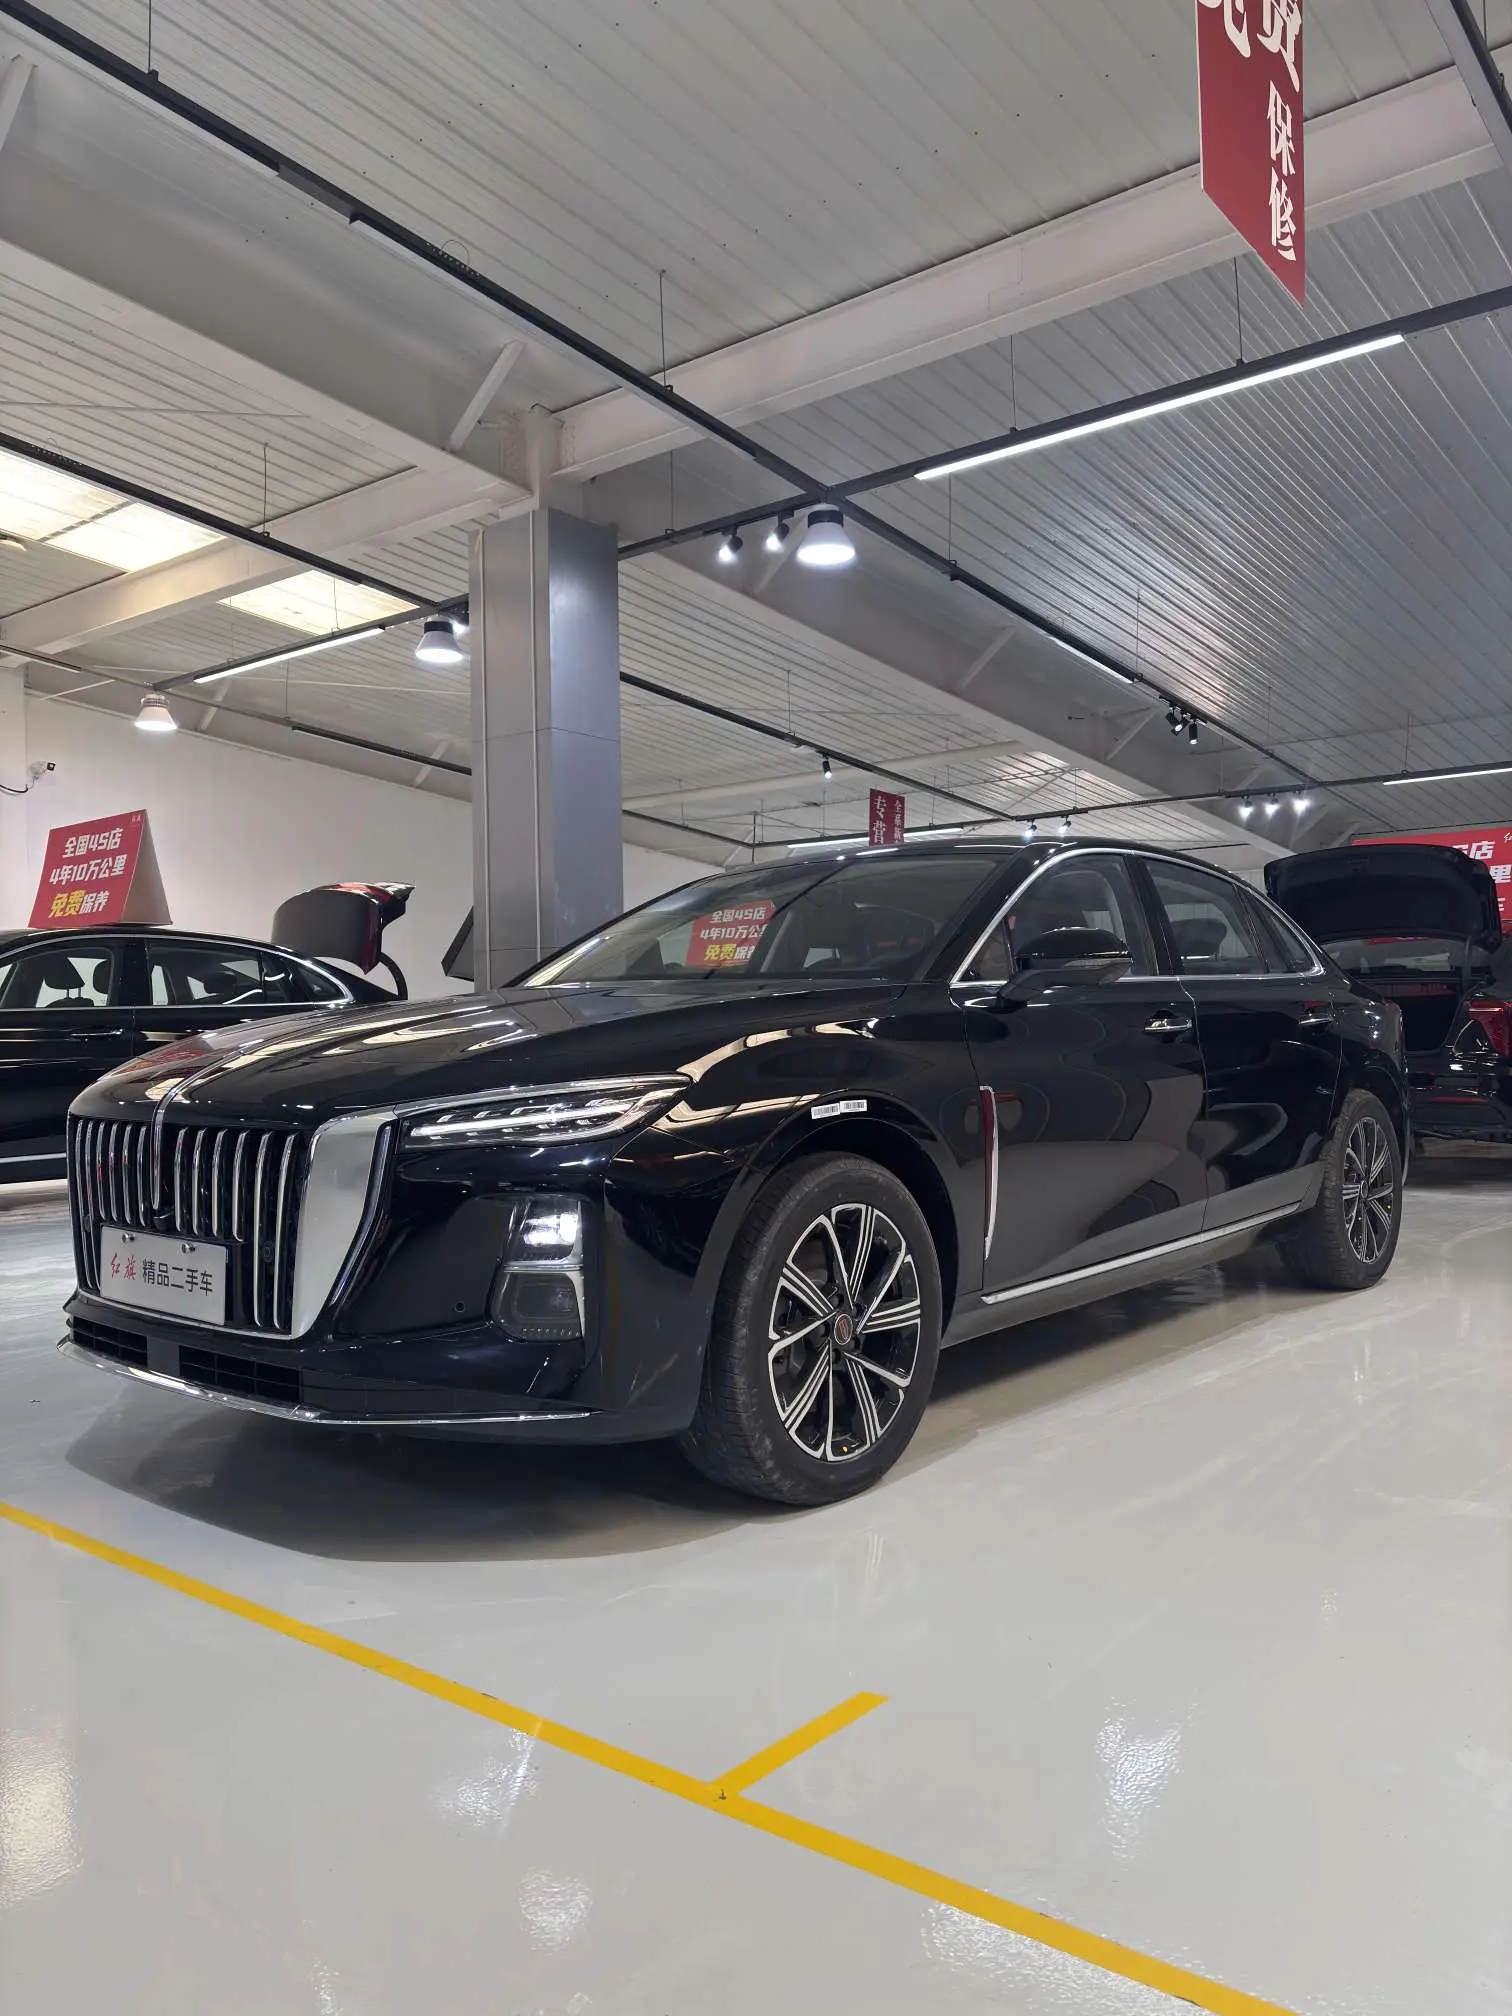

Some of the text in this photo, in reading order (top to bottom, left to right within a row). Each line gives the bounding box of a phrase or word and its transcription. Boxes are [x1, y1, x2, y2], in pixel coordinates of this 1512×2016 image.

[1267, 80, 1296, 261] 保修
[63, 828, 123, 858] 全国4S店
[49, 854, 127, 885] 4年10万公里
[48, 889, 110, 918] 免费保养
[709, 907, 767, 923] 全国4S店
[110, 1252, 213, 1296] 红旗 精品二手车
